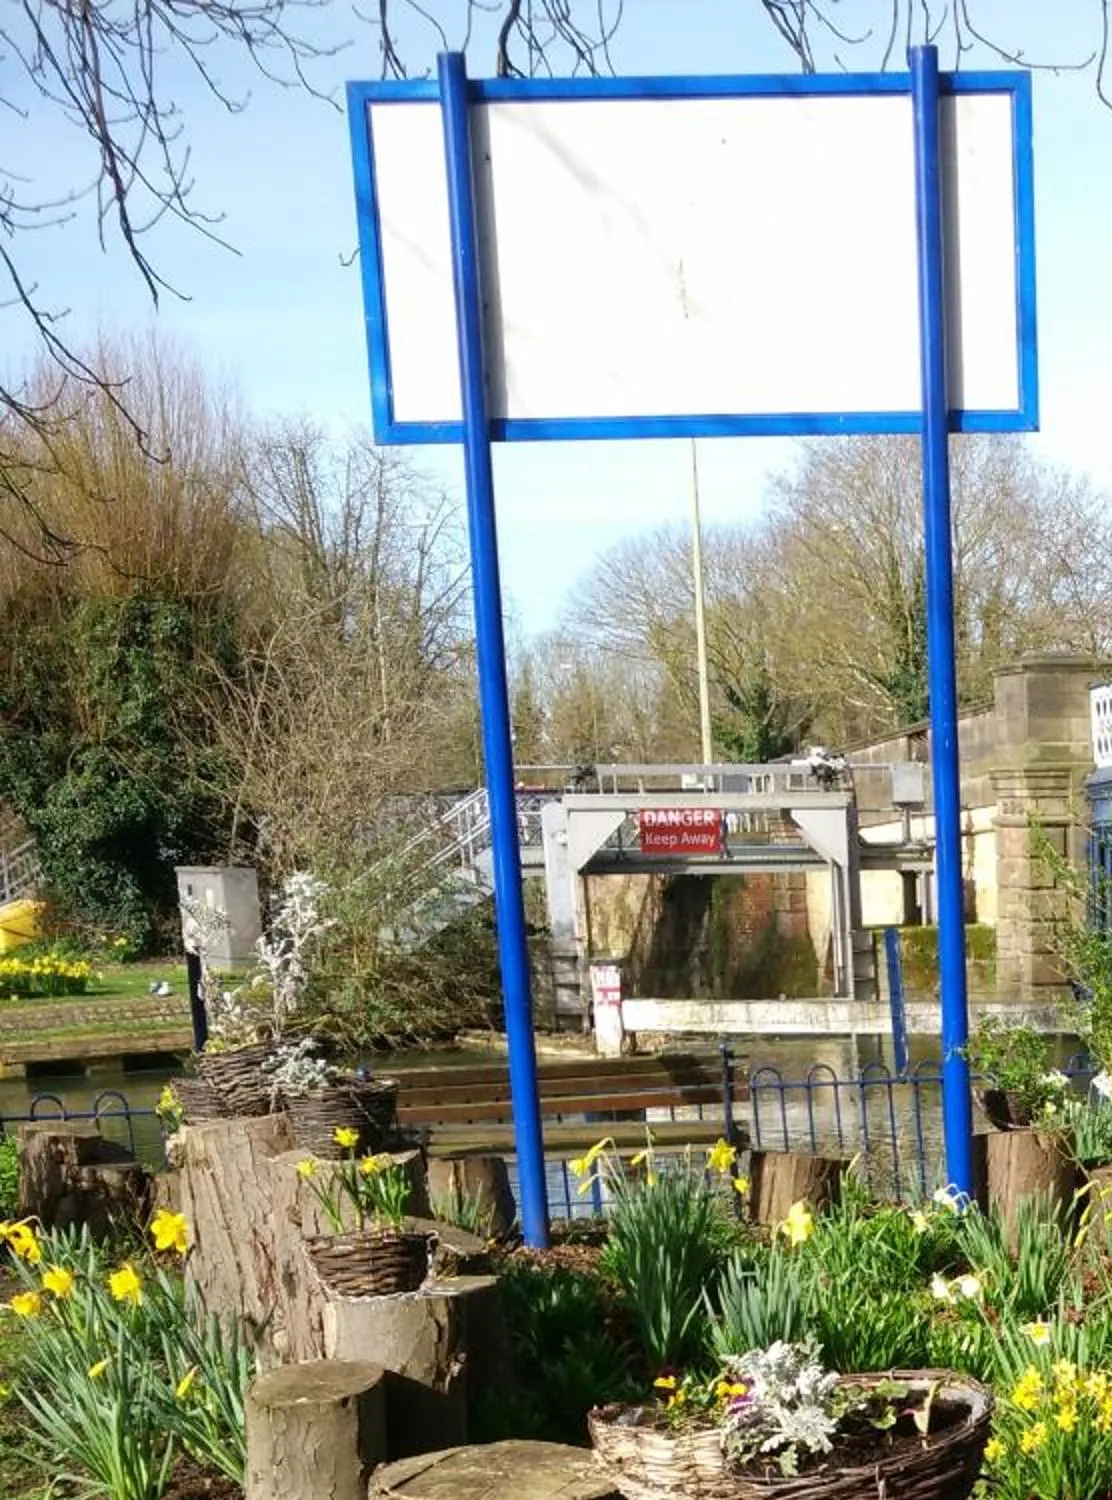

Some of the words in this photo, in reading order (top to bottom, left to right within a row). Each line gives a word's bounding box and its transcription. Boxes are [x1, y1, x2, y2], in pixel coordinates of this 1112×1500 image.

[644, 810, 714, 826] DANGER
[645, 832, 677, 847] Keep
[681, 832, 715, 848] Away
